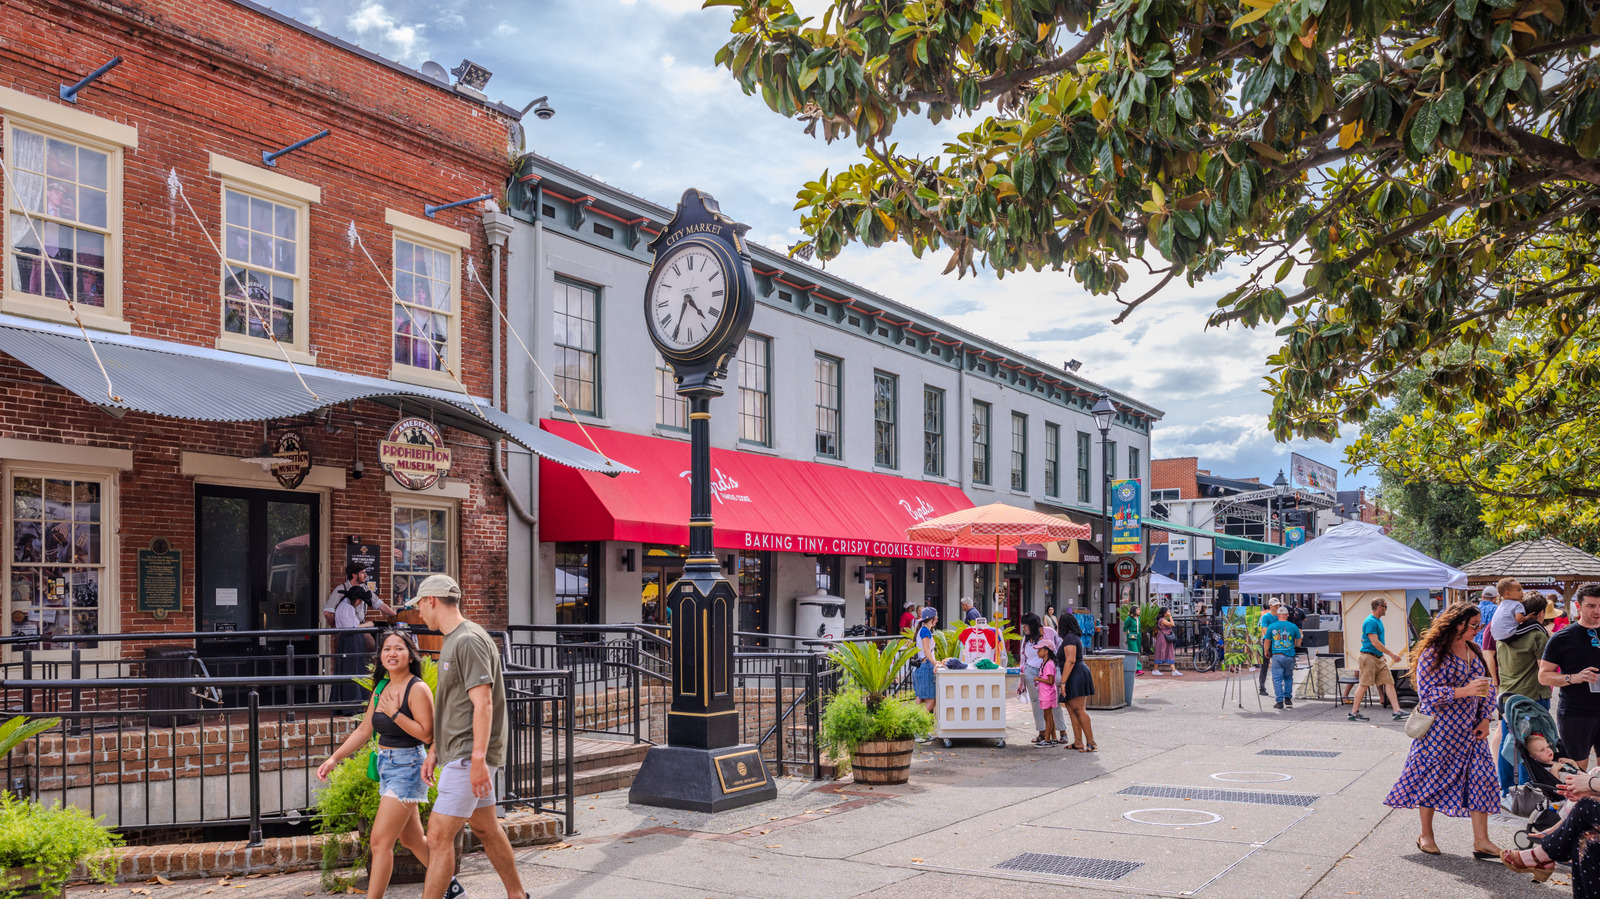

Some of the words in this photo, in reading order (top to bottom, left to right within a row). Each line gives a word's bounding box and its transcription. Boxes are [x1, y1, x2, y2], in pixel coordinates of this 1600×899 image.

[666, 228, 684, 246] CITY
[686, 223, 722, 235] MARKET
[398, 420, 435, 435] AMERICAN
[383, 445, 450, 462] PROHIBITION
[278, 464, 300, 472] MUSEUM
[397, 460, 436, 472] MUSEUM
[898, 496, 934, 522] Byrd's
[745, 532, 792, 549] BAKING
[798, 537, 828, 551] TINY,
[832, 540, 870, 553] CRISPY
[874, 542, 914, 556] COOKIES
[916, 546, 940, 558] SINCE
[944, 548, 960, 558] 1924
